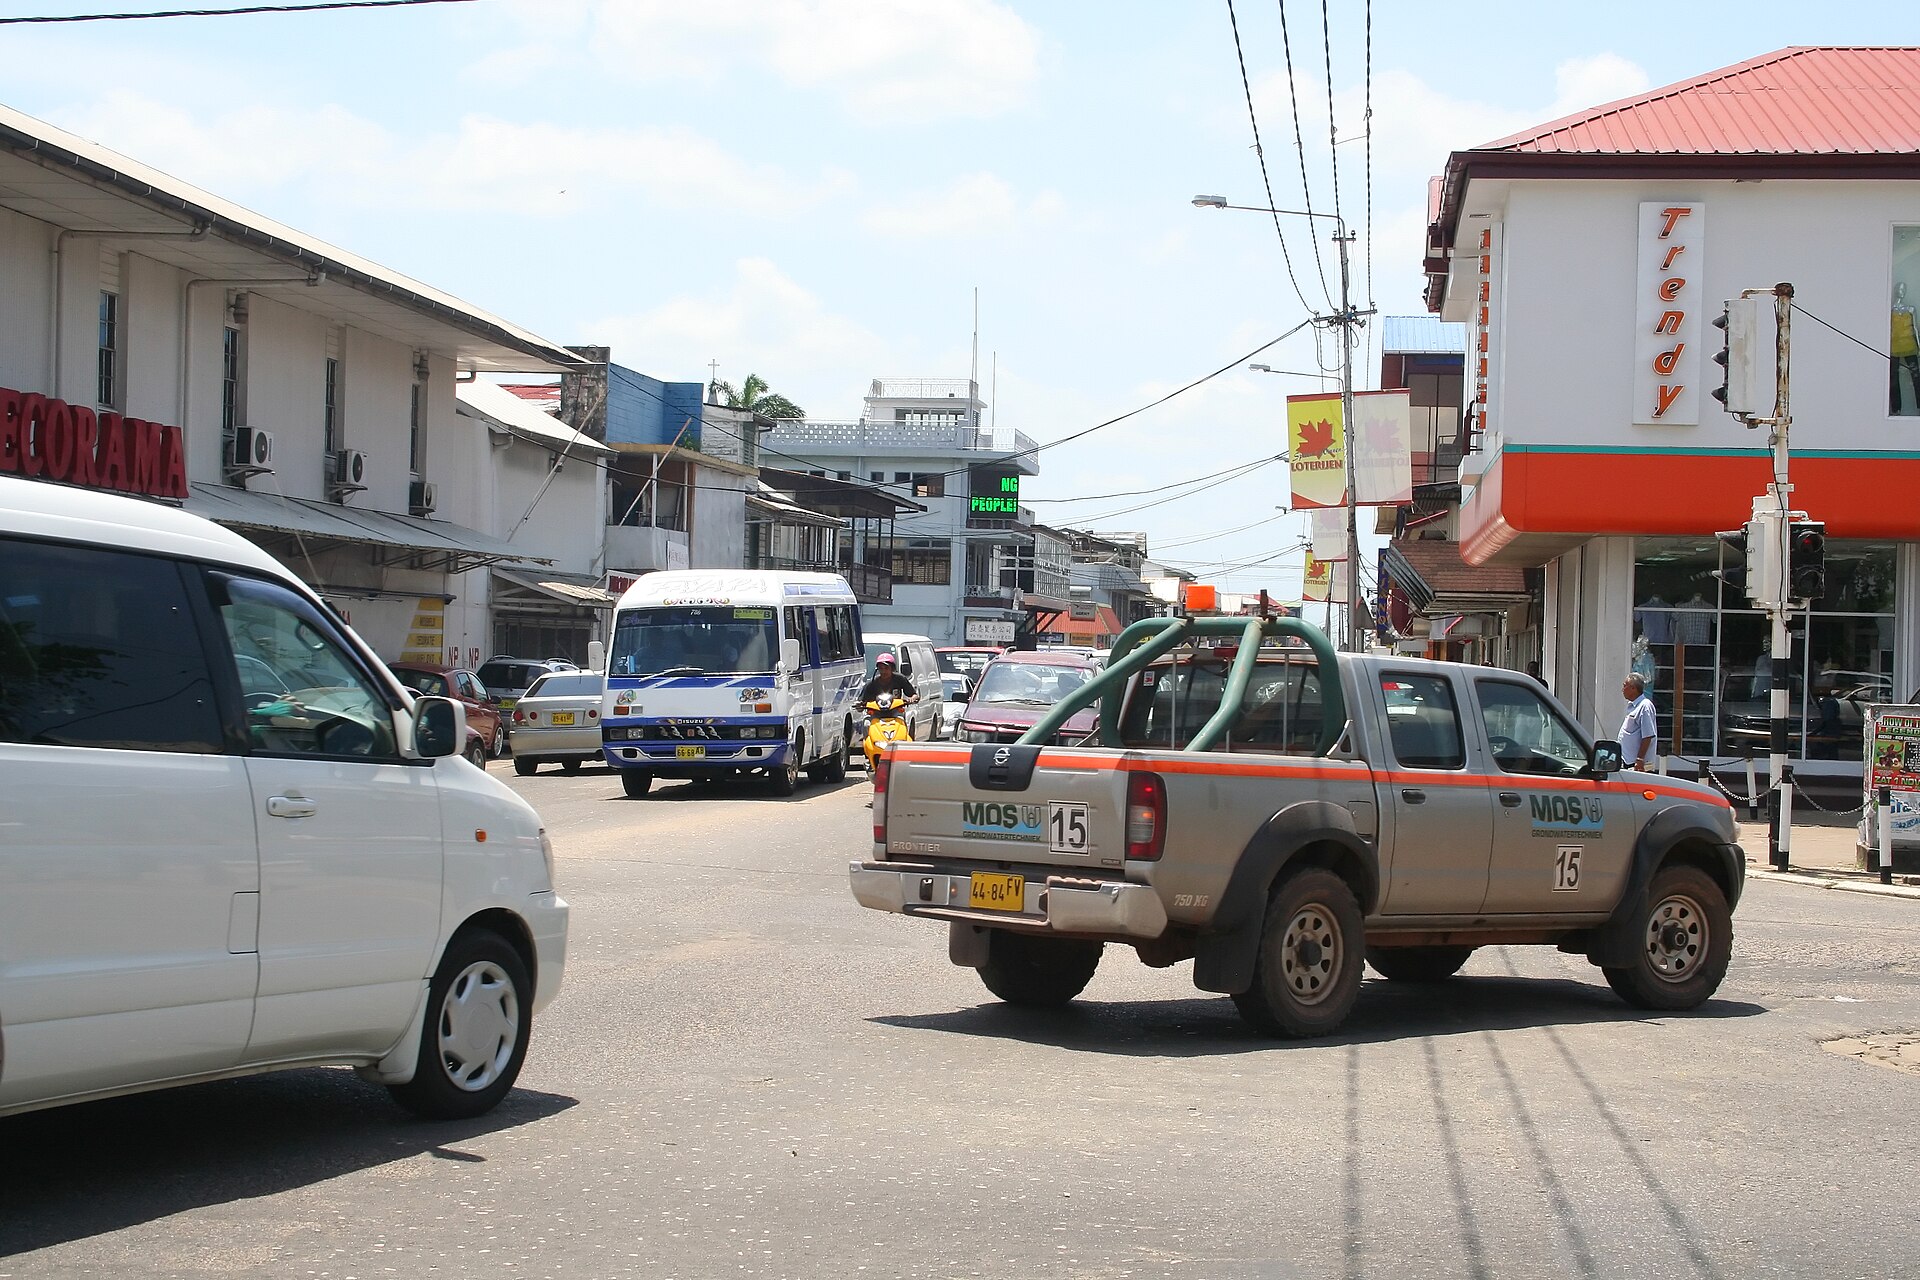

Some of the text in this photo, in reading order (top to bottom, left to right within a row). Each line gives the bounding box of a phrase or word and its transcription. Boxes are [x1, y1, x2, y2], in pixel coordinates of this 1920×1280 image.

[1652, 207, 1692, 418] Trendy
[1290, 459, 1343, 473] LOTERIJEN
[1001, 478, 1018, 492] NG
[448, 647, 459, 666] NP
[469, 647, 480, 669] NP
[1874, 775, 1892, 784] ZAT
[963, 802, 1018, 828] MOS
[1529, 794, 1583, 825] MOS
[1051, 808, 1086, 848] 15
[892, 841, 941, 852] FRONTIER
[1556, 851, 1580, 888] 15
